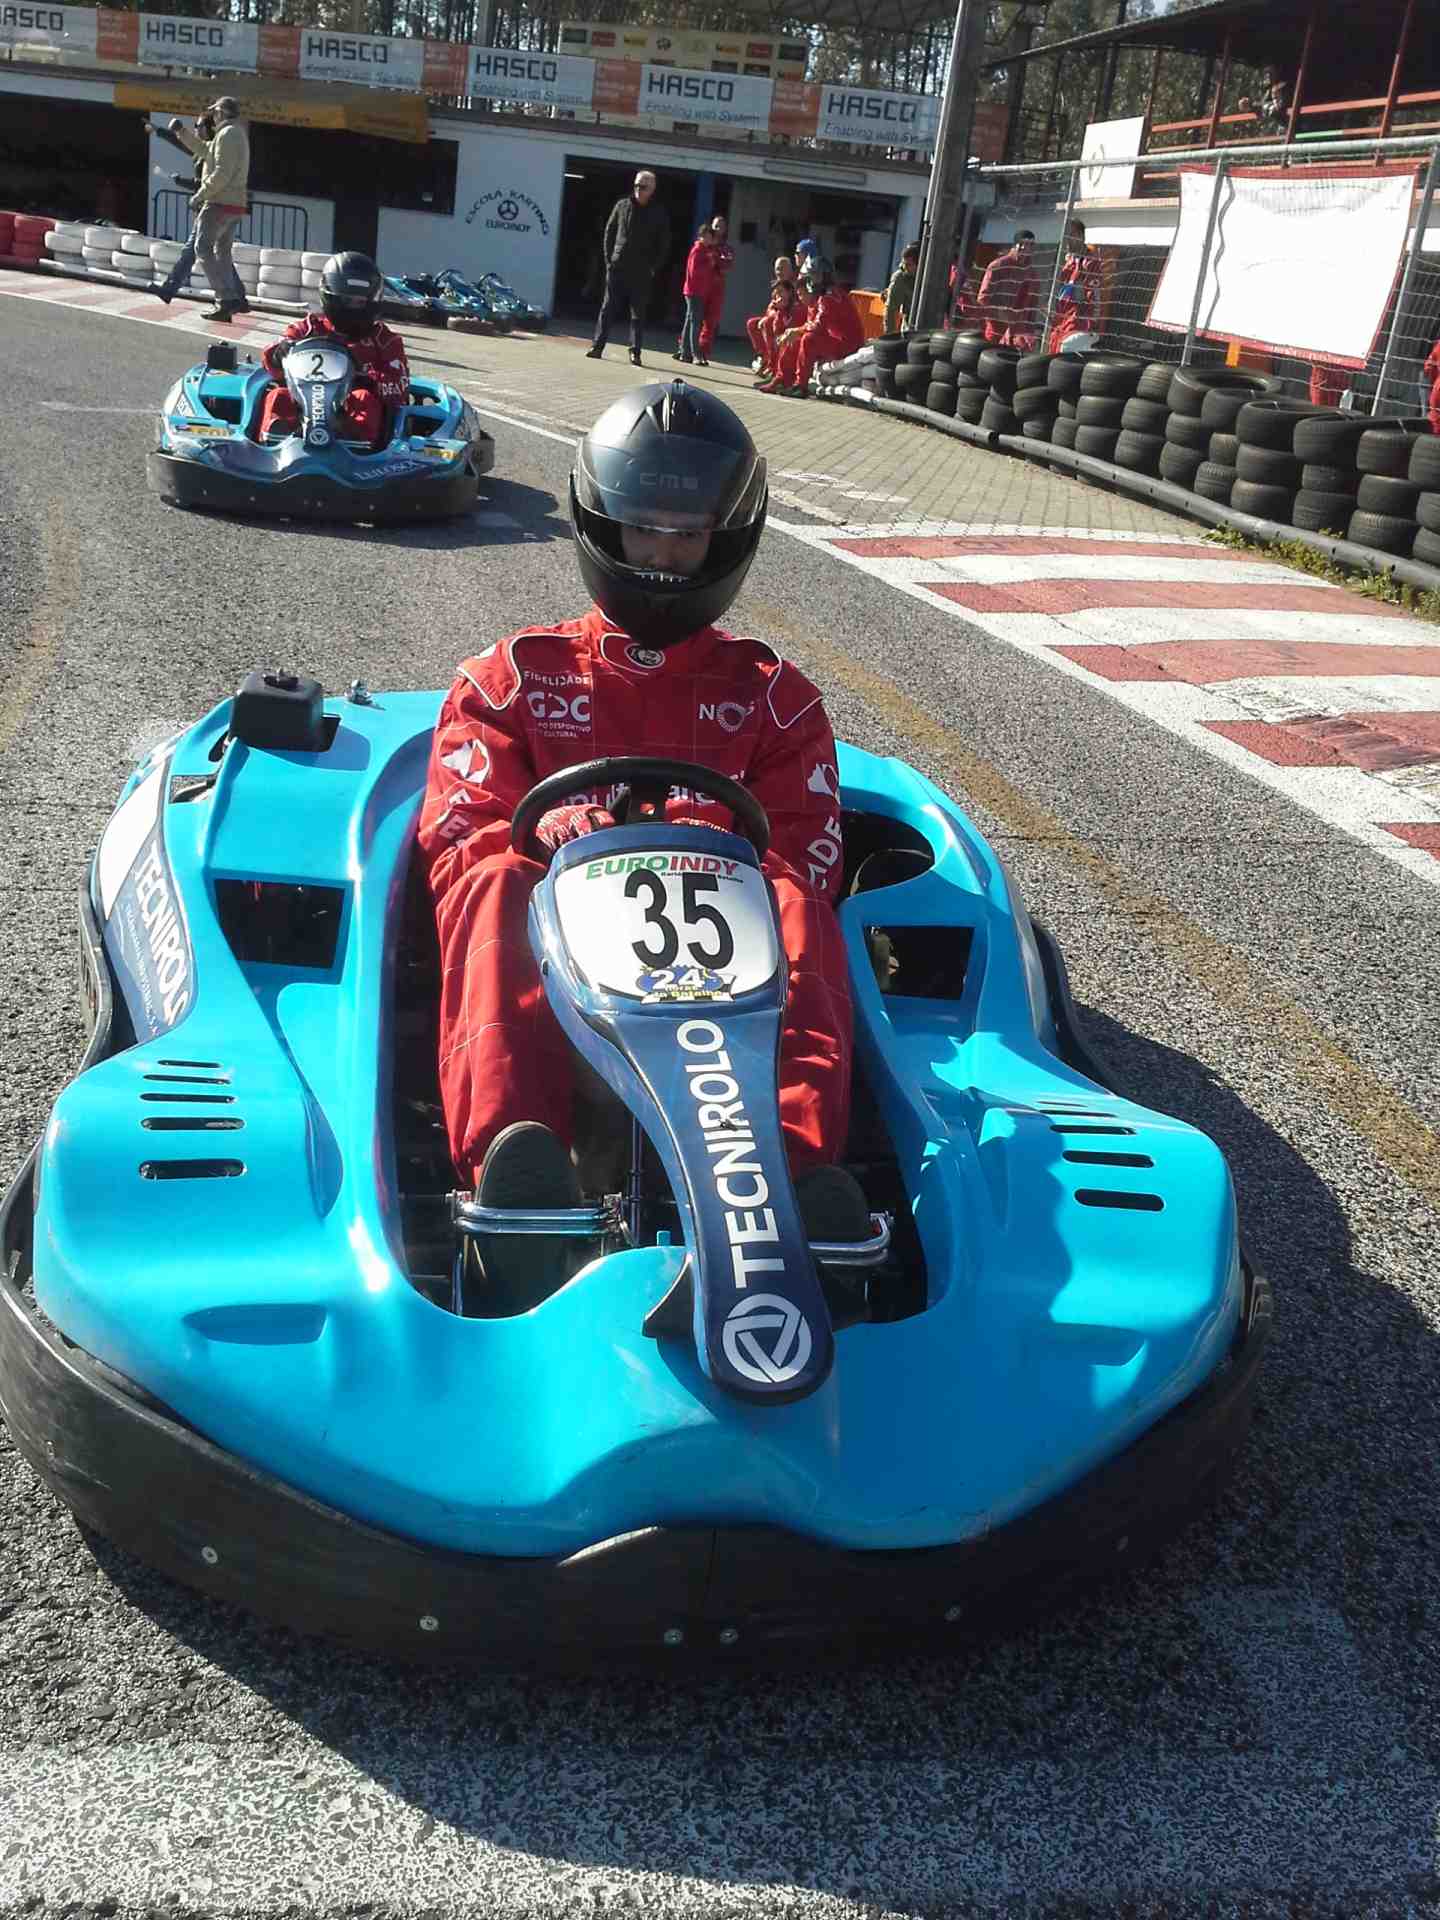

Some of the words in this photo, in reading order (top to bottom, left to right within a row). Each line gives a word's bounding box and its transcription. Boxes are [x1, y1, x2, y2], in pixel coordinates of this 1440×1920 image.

[0, 6, 64, 31] ASCO
[146, 22, 223, 47] HASCO
[308, 37, 388, 64] HASCO
[476, 54, 557, 82] HASCO
[648, 73, 733, 102] HASCO
[827, 93, 917, 123] HASCO
[311, 354, 325, 376] 2
[524, 671, 590, 686] FIDELIDADE
[528, 691, 591, 722] GDC
[586, 856, 738, 880] EUROINDY
[624, 868, 734, 970] 35
[676, 1019, 786, 1289] TECNIROLO
